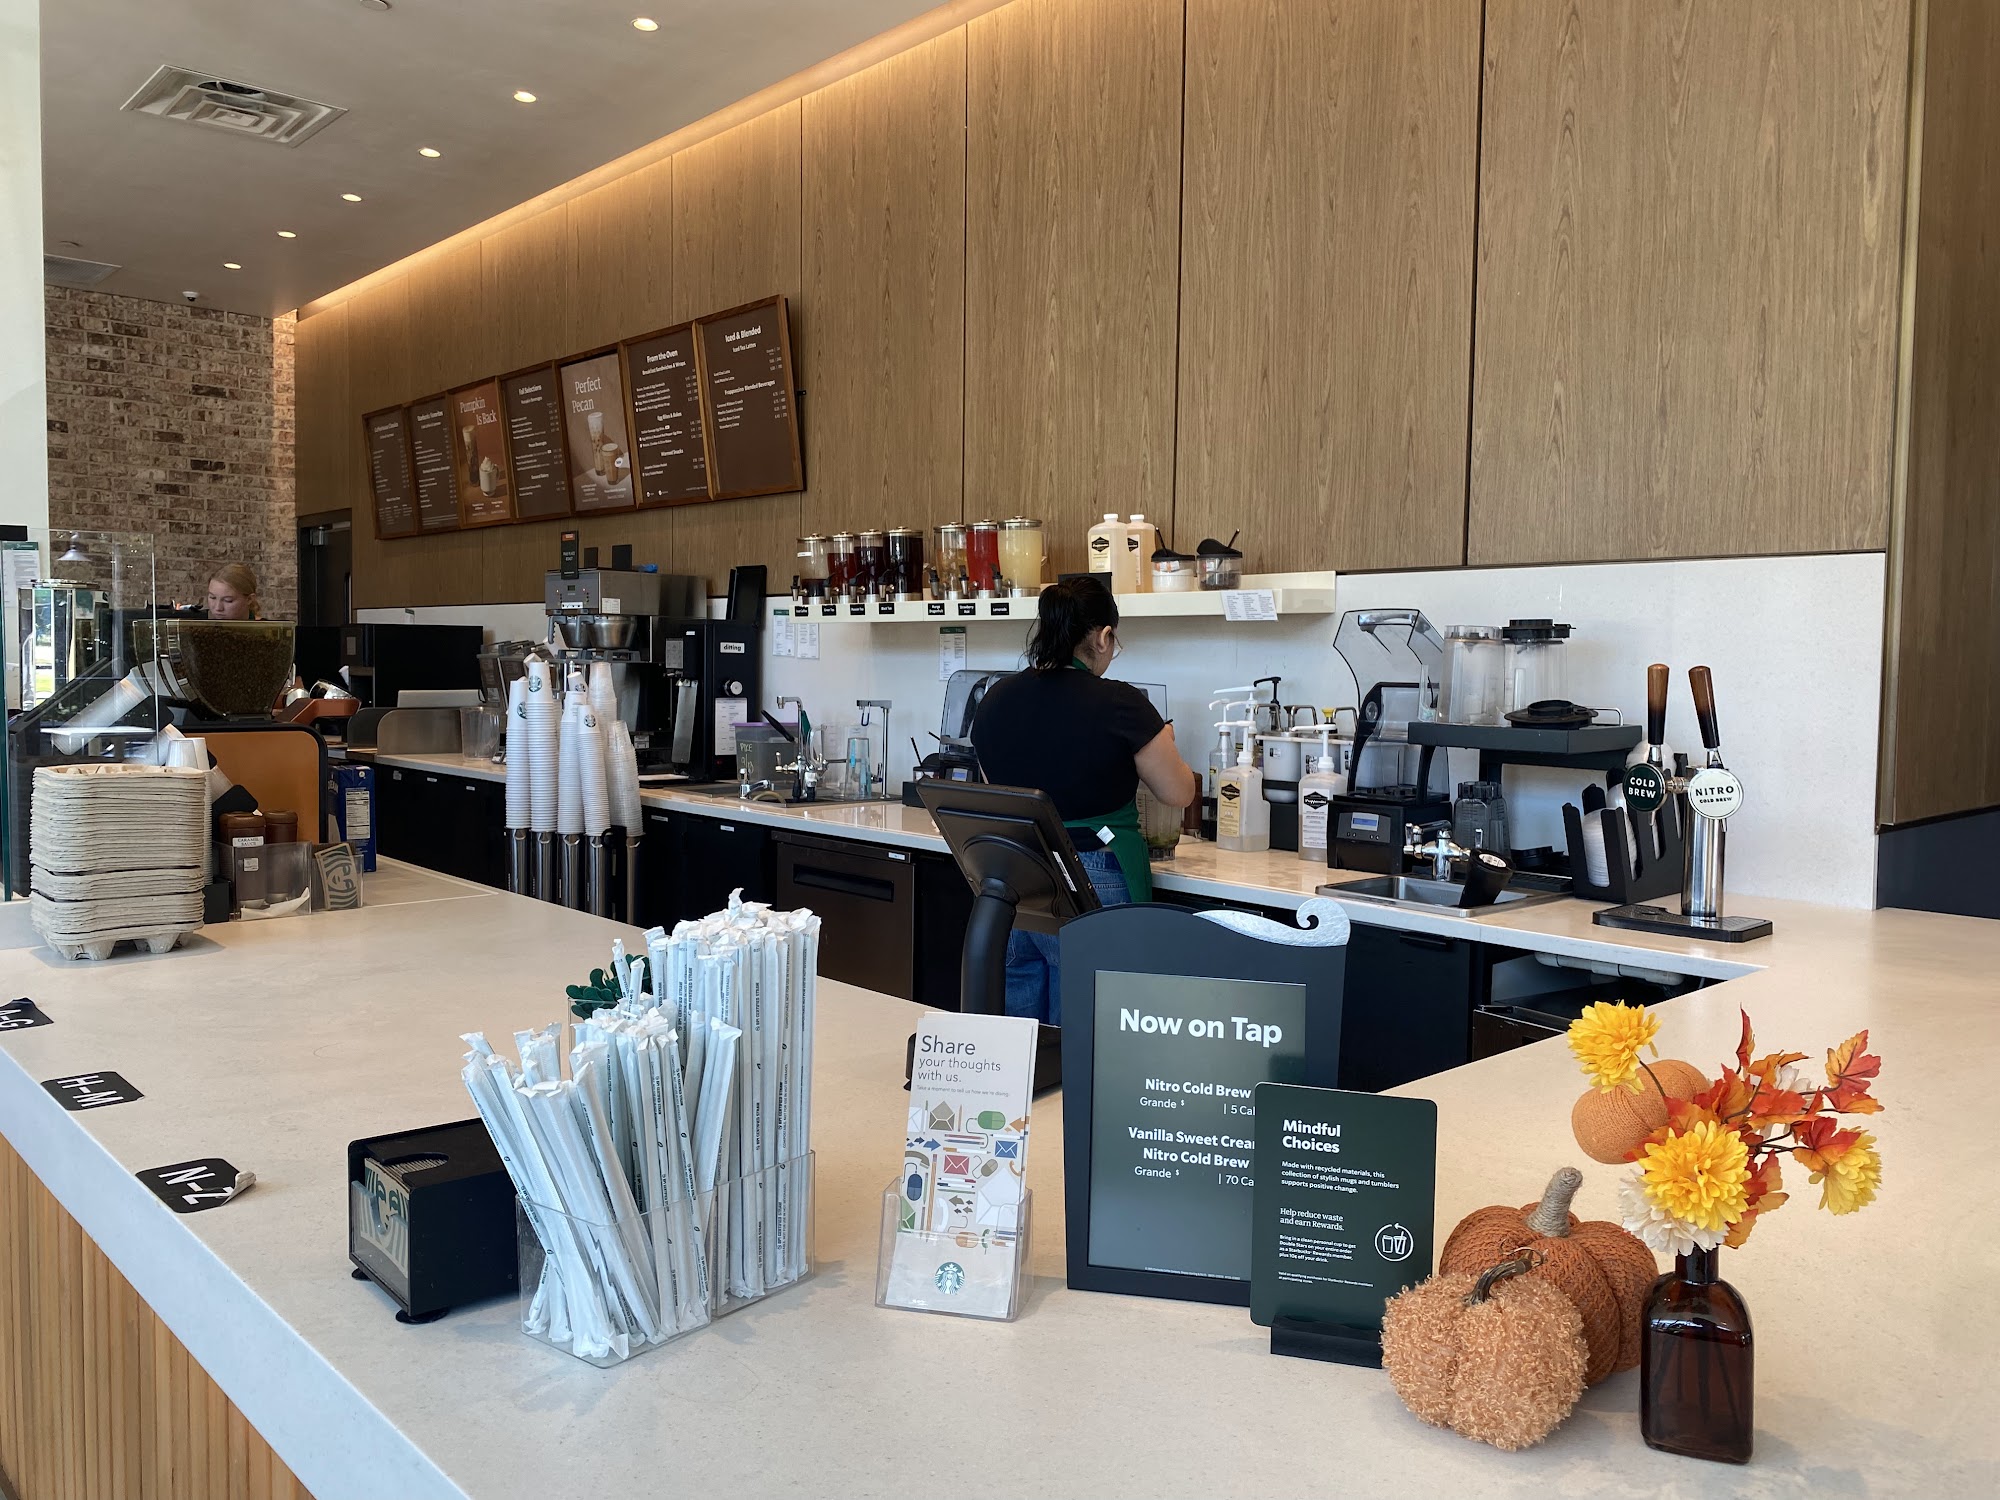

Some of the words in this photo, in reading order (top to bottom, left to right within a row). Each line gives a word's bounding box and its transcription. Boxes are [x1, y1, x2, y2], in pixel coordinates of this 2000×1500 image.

[725, 332, 736, 342] Iced
[736, 332, 740, 340] &
[741, 326, 761, 338] Blended
[575, 377, 601, 394] Perfect
[460, 397, 486, 413] Pumpkin
[572, 399, 594, 413] Pecan
[476, 415, 482, 425] Is
[482, 410, 497, 425] Back
[723, 644, 742, 652] ditting
[1629, 776, 1656, 788] COLD
[1628, 787, 1656, 798] BREW
[1695, 785, 1735, 797] NITRO
[1120, 1008, 1183, 1035] Now
[1188, 1018, 1224, 1038] on
[1231, 1016, 1282, 1048] Tap
[921, 1035, 976, 1055] Share
[918, 1058, 945, 1069] your
[949, 1057, 1001, 1073] thoughts
[918, 1070, 941, 1081] with
[946, 1073, 961, 1082] us.
[57, 1075, 124, 1108] H-M
[1145, 1078, 1180, 1092] Nitro
[1182, 1082, 1212, 1095] Cold
[1216, 1084, 1251, 1098] Brew
[1140, 1097, 1177, 1109] Grande
[1230, 1105, 1237, 1114] 5
[1239, 1106, 1256, 1116] Cal
[1128, 1127, 1174, 1142] Vanilla
[1176, 1131, 1218, 1146] Sweet
[1283, 1119, 1341, 1137] Mindful
[1282, 1136, 1340, 1153] Choices
[1143, 1148, 1178, 1162] Nitro
[1180, 1151, 1211, 1165] Cold
[1214, 1154, 1250, 1168] Brew
[1134, 1166, 1172, 1178] Grande
[1226, 1175, 1239, 1185] 70
[1240, 1176, 1254, 1186] Ca
[1281, 1161, 1299, 1169] Made
[1342, 1168, 1372, 1178] materials,
[158, 1166, 234, 1206] N-Z
[1281, 1170, 1311, 1179] collection
[1320, 1174, 1339, 1182] stylish
[1371, 1180, 1399, 1189] tumblers
[1334, 1185, 1358, 1193] change.
[1280, 1208, 1296, 1217] Help
[1297, 1210, 1321, 1219] reduce
[1280, 1217, 1294, 1225] and
[1295, 1219, 1311, 1227] earn
[1312, 1221, 1344, 1231] Rewards.
